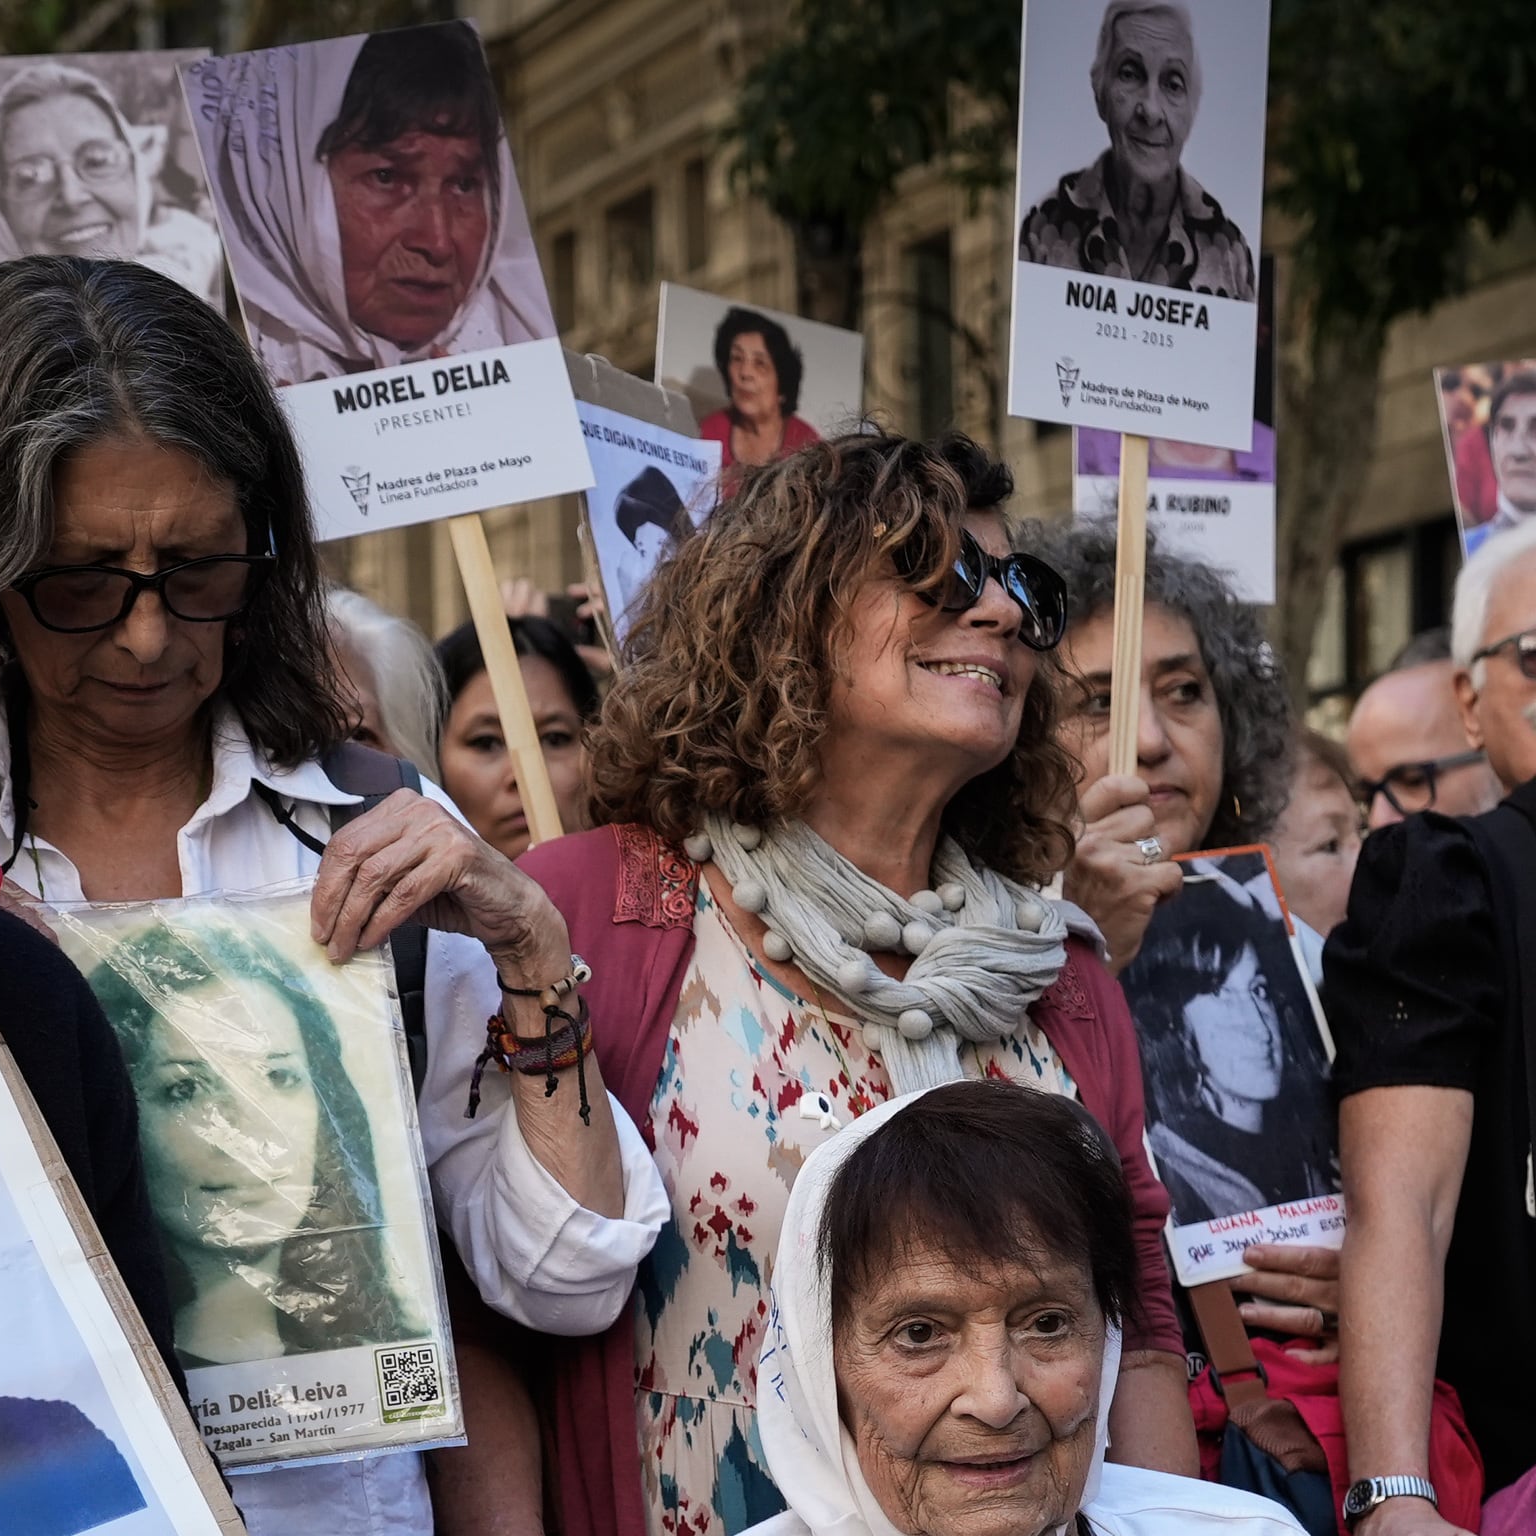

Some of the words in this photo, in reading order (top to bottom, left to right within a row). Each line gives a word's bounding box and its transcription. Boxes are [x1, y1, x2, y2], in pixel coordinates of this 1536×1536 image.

[1066, 280, 1118, 314] NOIA
[1127, 292, 1209, 330] JOSEFA
[1096, 322, 1127, 340] 2021
[1142, 330, 1174, 348] 2015
[333, 370, 425, 414] MOREL
[432, 359, 511, 396] DELIA
[1081, 381, 1119, 396] Madres
[1122, 385, 1135, 398] de
[1137, 389, 1164, 404] Plaza
[1167, 393, 1180, 405] de
[1182, 395, 1210, 411] Mayo
[374, 403, 472, 436] ¡PRESENTE!
[1109, 396, 1162, 415] Fundadora
[603, 426, 636, 451] DIGAN
[376, 473, 423, 493] Madres
[426, 469, 442, 483] de
[444, 464, 478, 481] Plaza
[480, 460, 496, 473] de
[499, 453, 533, 471] Mayo
[413, 478, 479, 499] Fundadora
[1187, 1243, 1215, 1264] QUE
[229, 1389, 282, 1413] Delia
[292, 1382, 347, 1405] Leiva
[204, 1415, 282, 1437] Desaparecida
[213, 1436, 252, 1453] Zagala
[269, 1431, 290, 1443] San
[294, 1424, 336, 1440] Martín
